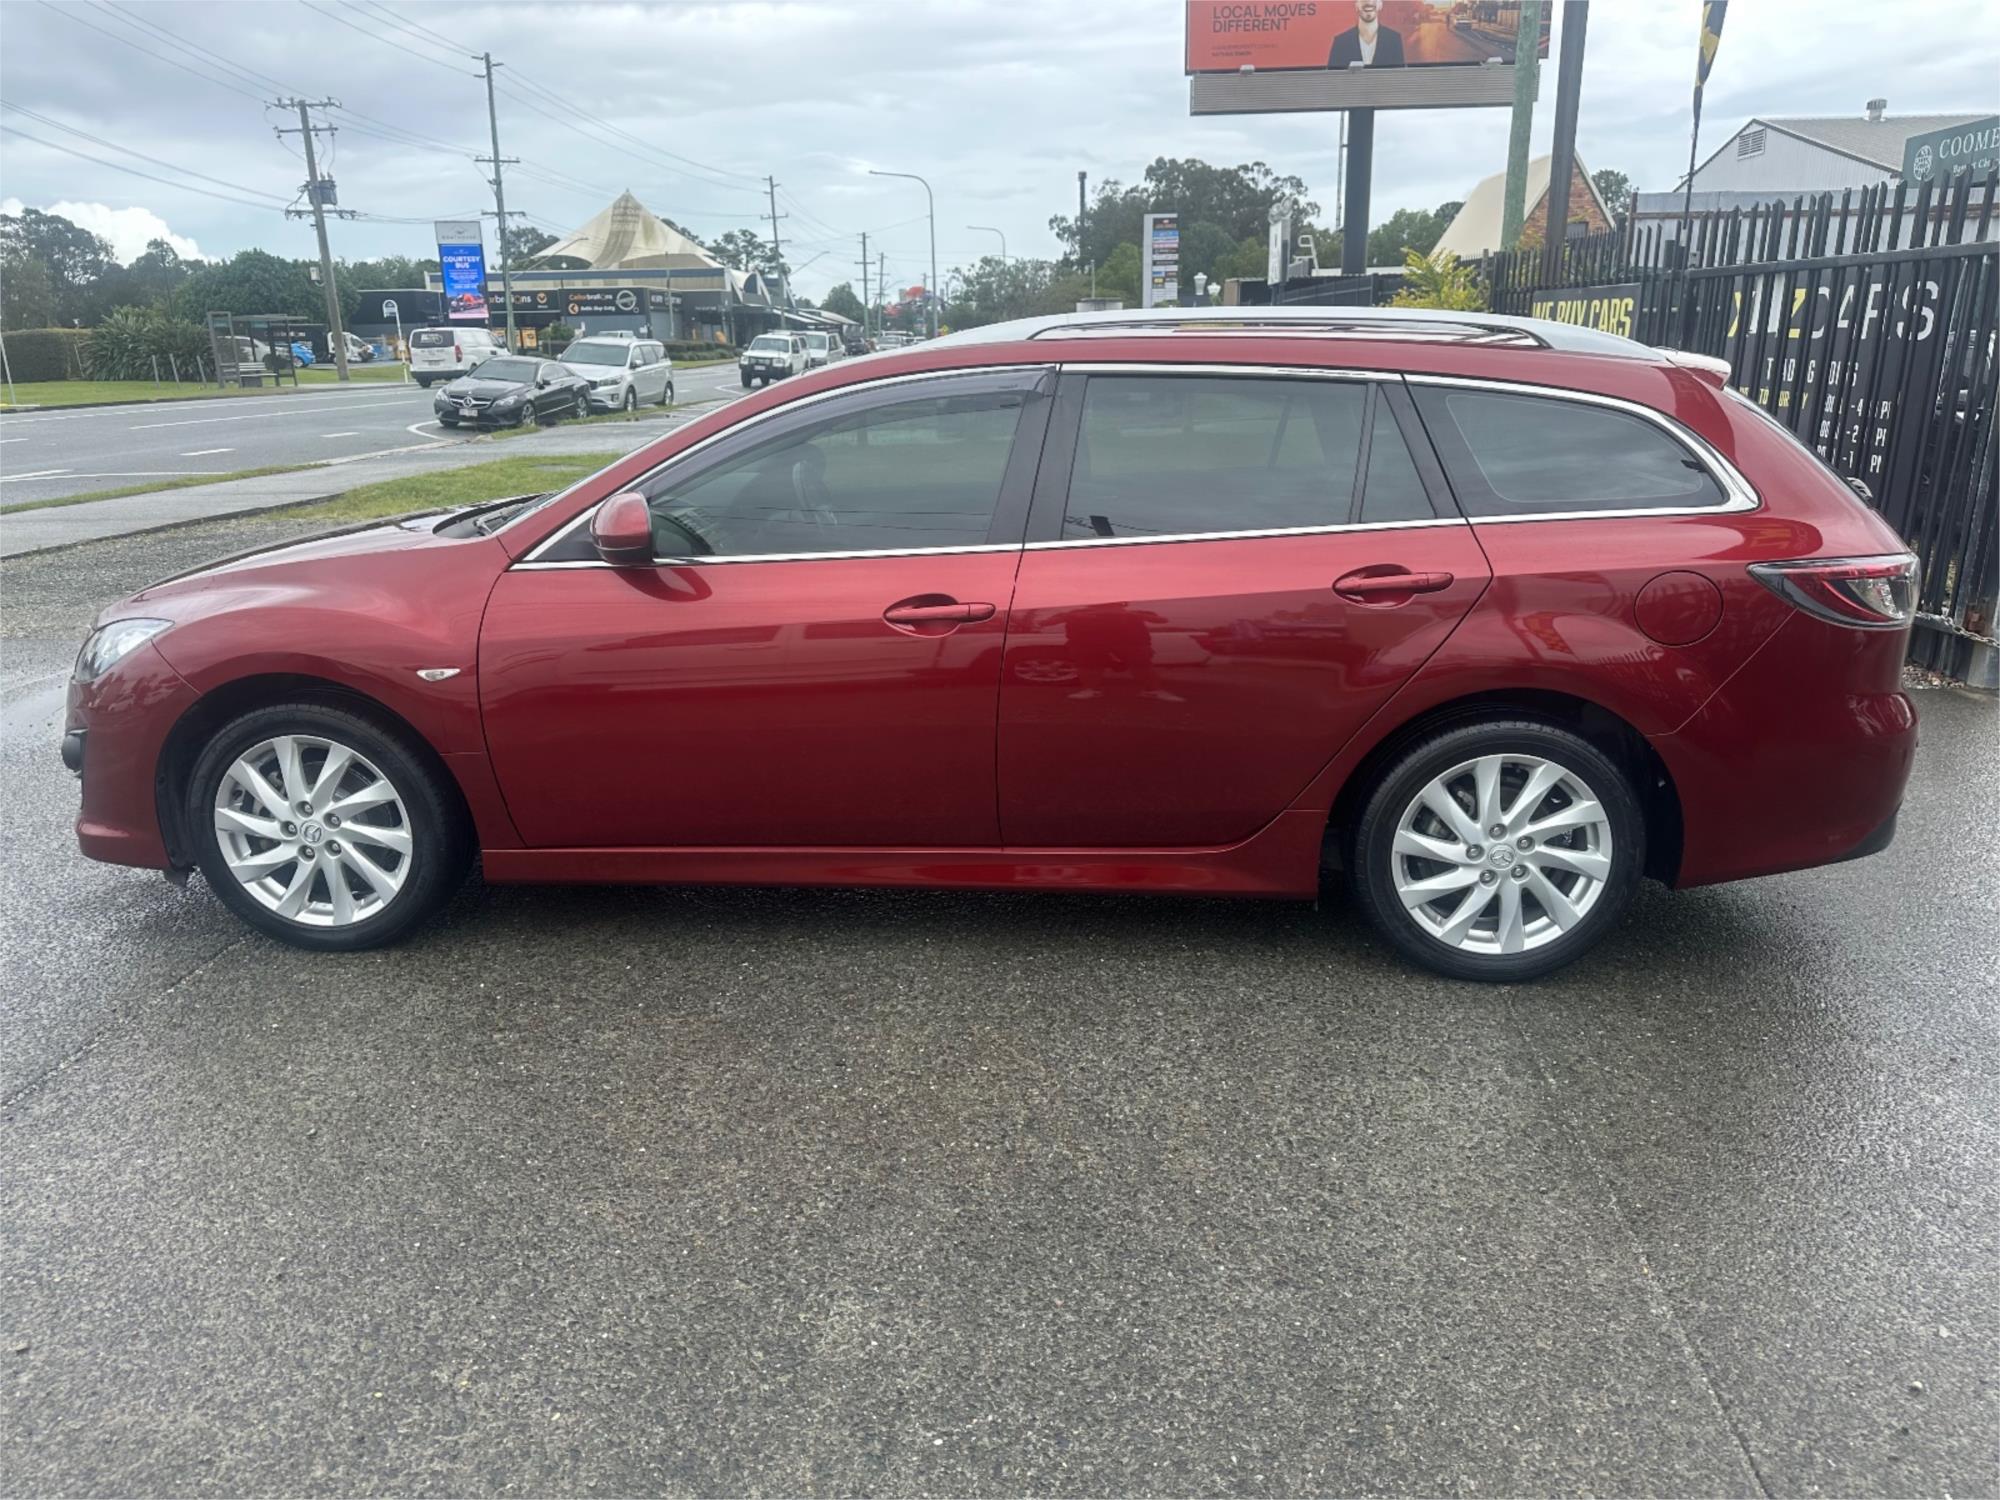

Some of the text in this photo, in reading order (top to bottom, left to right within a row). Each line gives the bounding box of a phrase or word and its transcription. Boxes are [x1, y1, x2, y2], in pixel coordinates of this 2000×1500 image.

[1213, 3, 1316, 19] LOCAL MOVES
[1212, 18, 1290, 33] DIFFERENT
[1556, 300, 1587, 327] BUY
[1588, 297, 1634, 338] CARS
